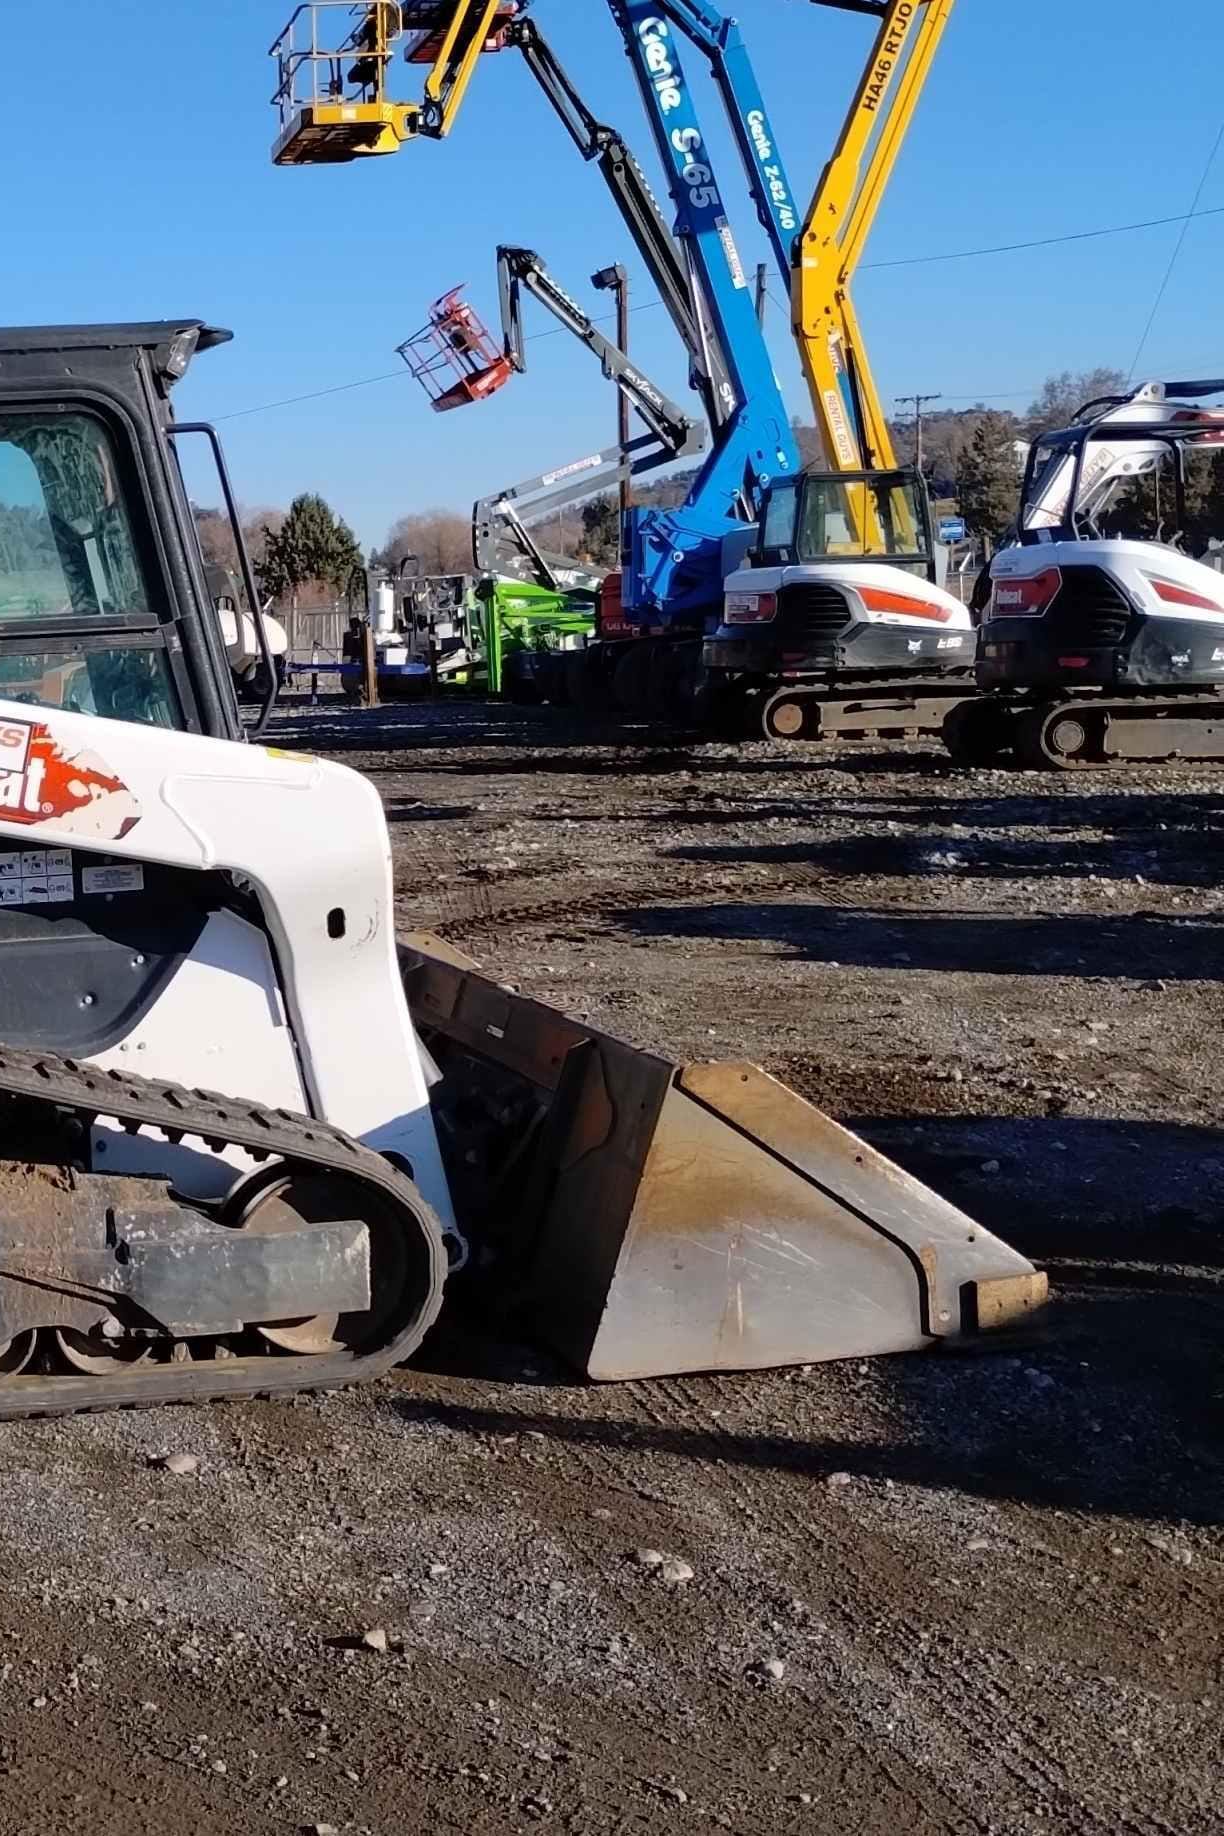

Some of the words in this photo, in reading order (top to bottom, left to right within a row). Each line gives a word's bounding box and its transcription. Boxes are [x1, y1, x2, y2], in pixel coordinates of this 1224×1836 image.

[638, 16, 681, 113] Genie
[862, 59, 892, 111] HA46
[671, 127, 720, 208] S-65
[747, 109, 772, 162] Genie
[764, 165, 795, 230] Z-62/40
